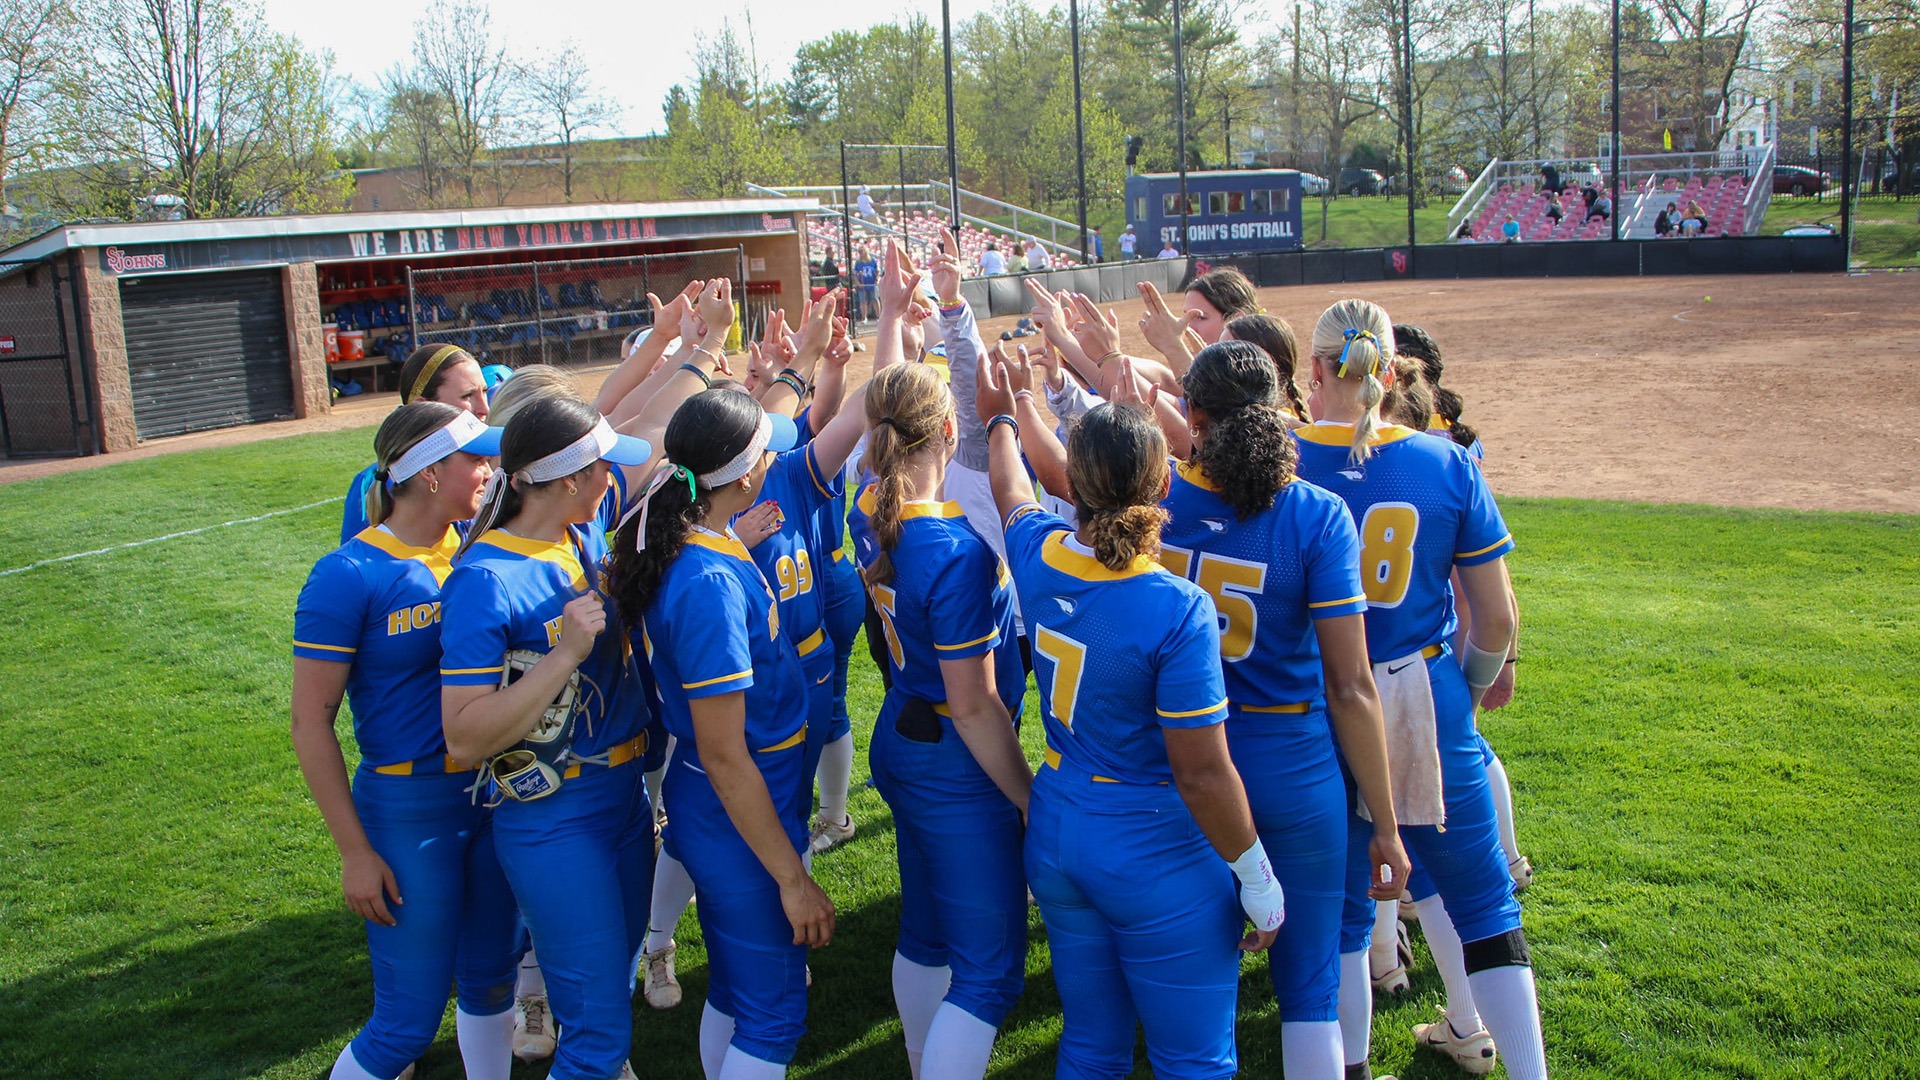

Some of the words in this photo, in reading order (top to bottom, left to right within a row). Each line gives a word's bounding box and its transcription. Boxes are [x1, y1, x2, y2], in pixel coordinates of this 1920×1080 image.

[349, 232, 387, 257] WE
[399, 229, 446, 254] ARE
[456, 226, 505, 250] NEW
[516, 221, 593, 247] YORK'S
[602, 217, 657, 241] TEAM
[1160, 226, 1180, 242] ST.
[1184, 223, 1228, 241] OHN'S
[1231, 221, 1293, 239] SOFTBALL
[775, 548, 813, 603] 99
[1359, 501, 1420, 609] 8
[1035, 622, 1087, 736] 7
